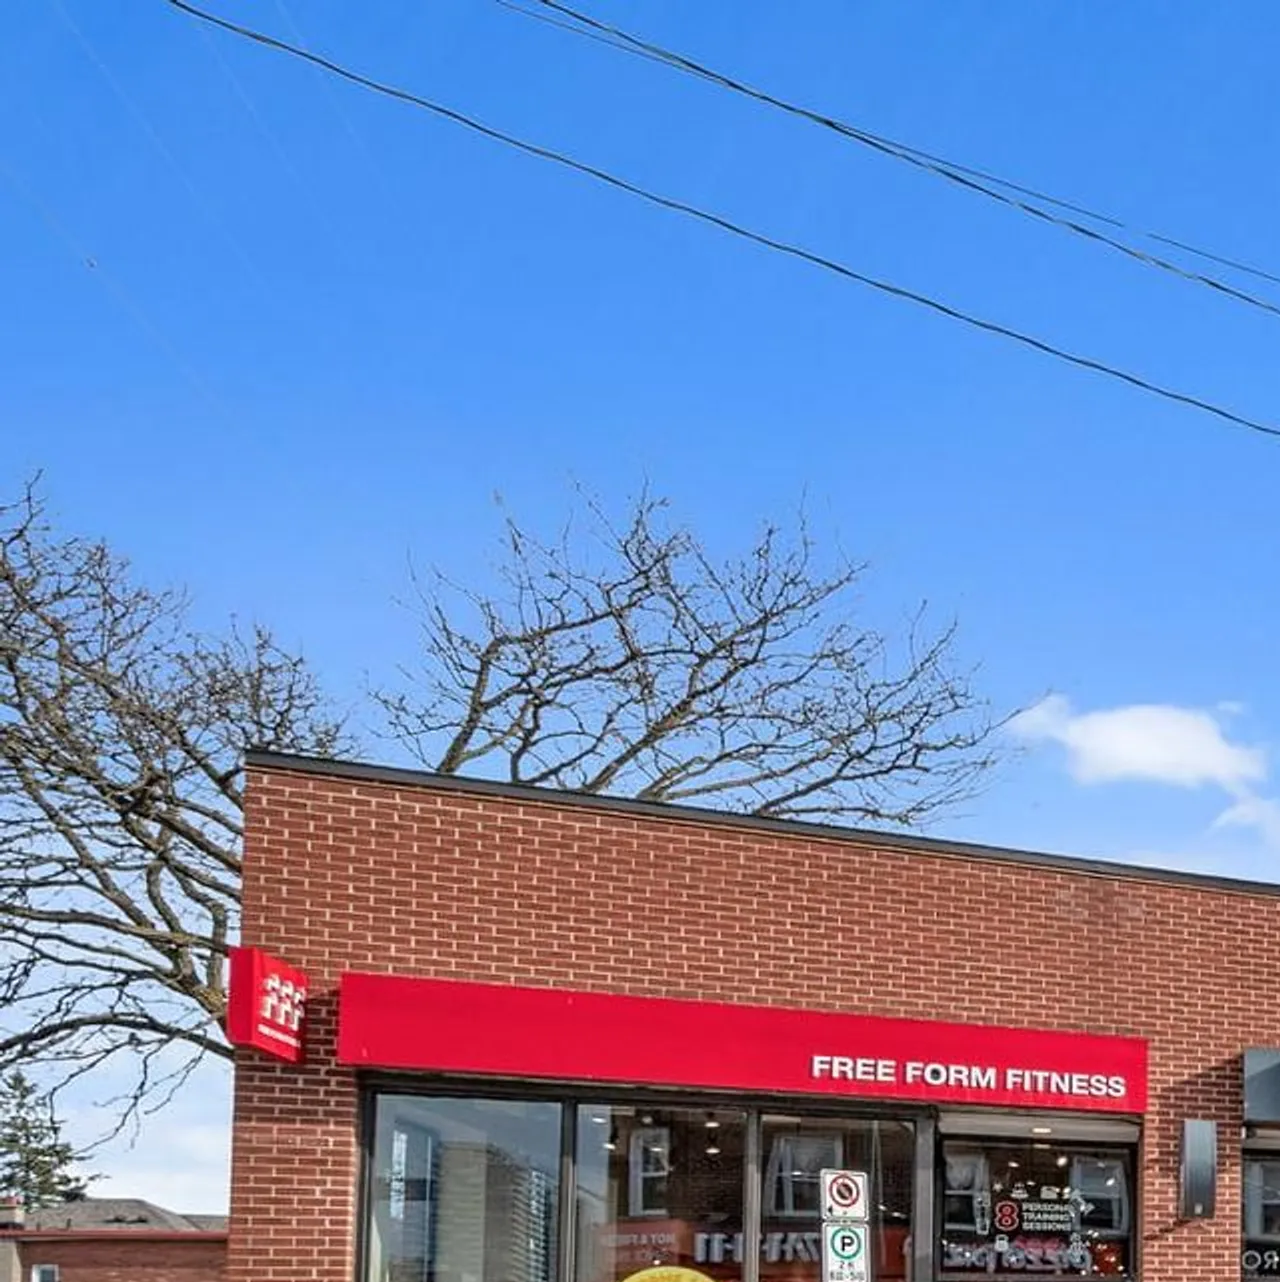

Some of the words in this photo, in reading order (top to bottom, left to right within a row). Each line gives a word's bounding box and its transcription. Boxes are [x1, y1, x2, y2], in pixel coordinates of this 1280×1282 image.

[811, 1055, 896, 1082] FREE
[905, 1061, 997, 1090] FORM
[1005, 1068, 1127, 1098] FITNESS
